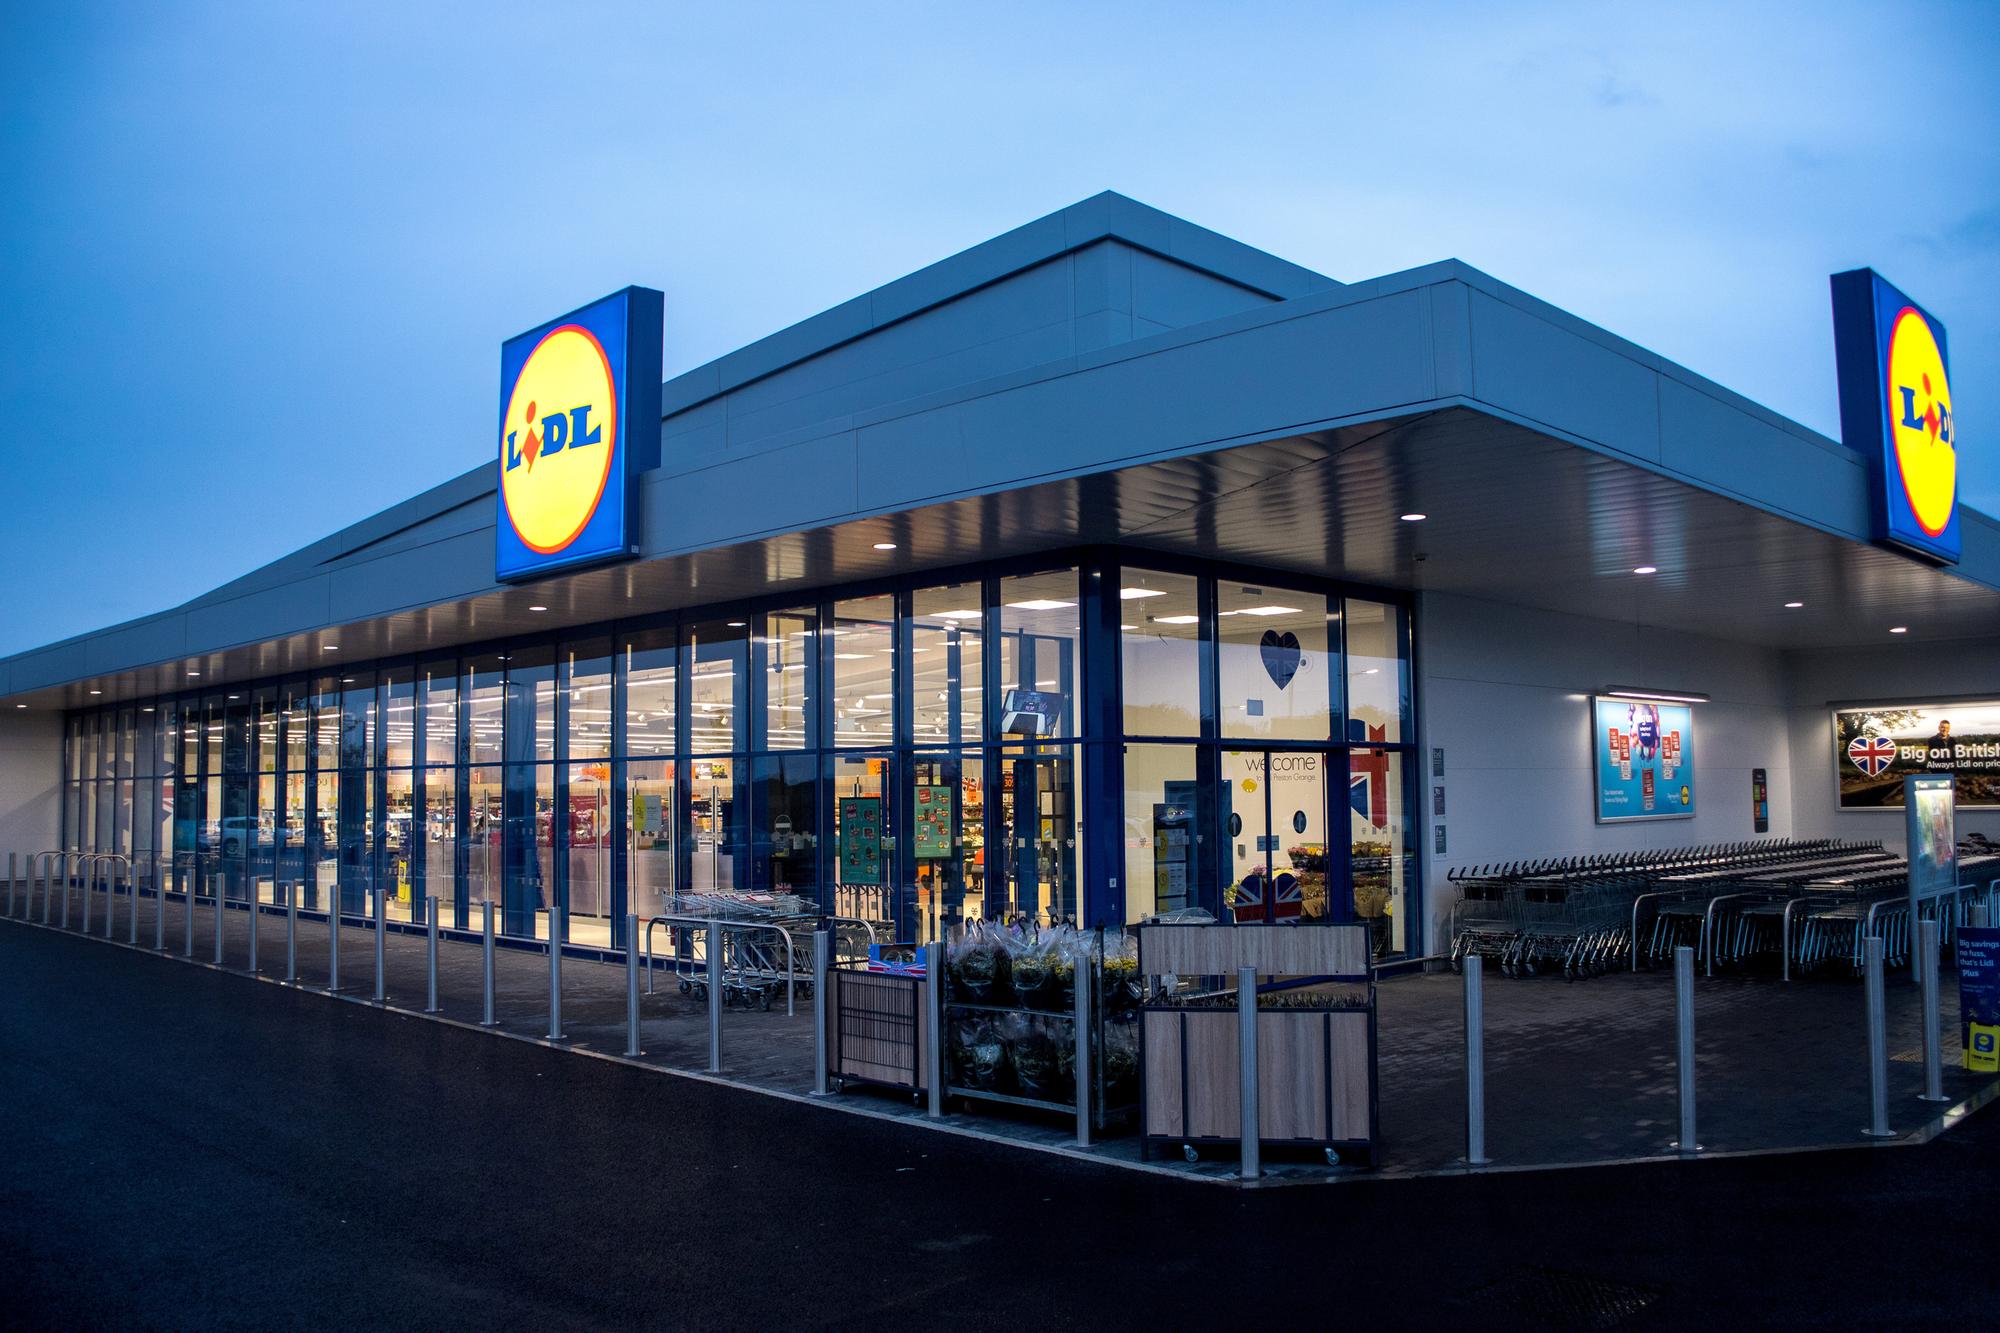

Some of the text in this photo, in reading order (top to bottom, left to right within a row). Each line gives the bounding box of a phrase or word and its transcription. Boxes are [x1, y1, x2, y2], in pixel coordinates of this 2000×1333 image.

[1901, 745, 1926, 763] Big
[1930, 747, 1950, 759] on
[1245, 756, 1316, 771] wecome
[1926, 761, 1954, 769] Always
[1956, 759, 1971, 768] Lidl
[1979, 959, 1994, 967] Lidl
[1962, 969, 1980, 977] Plus
